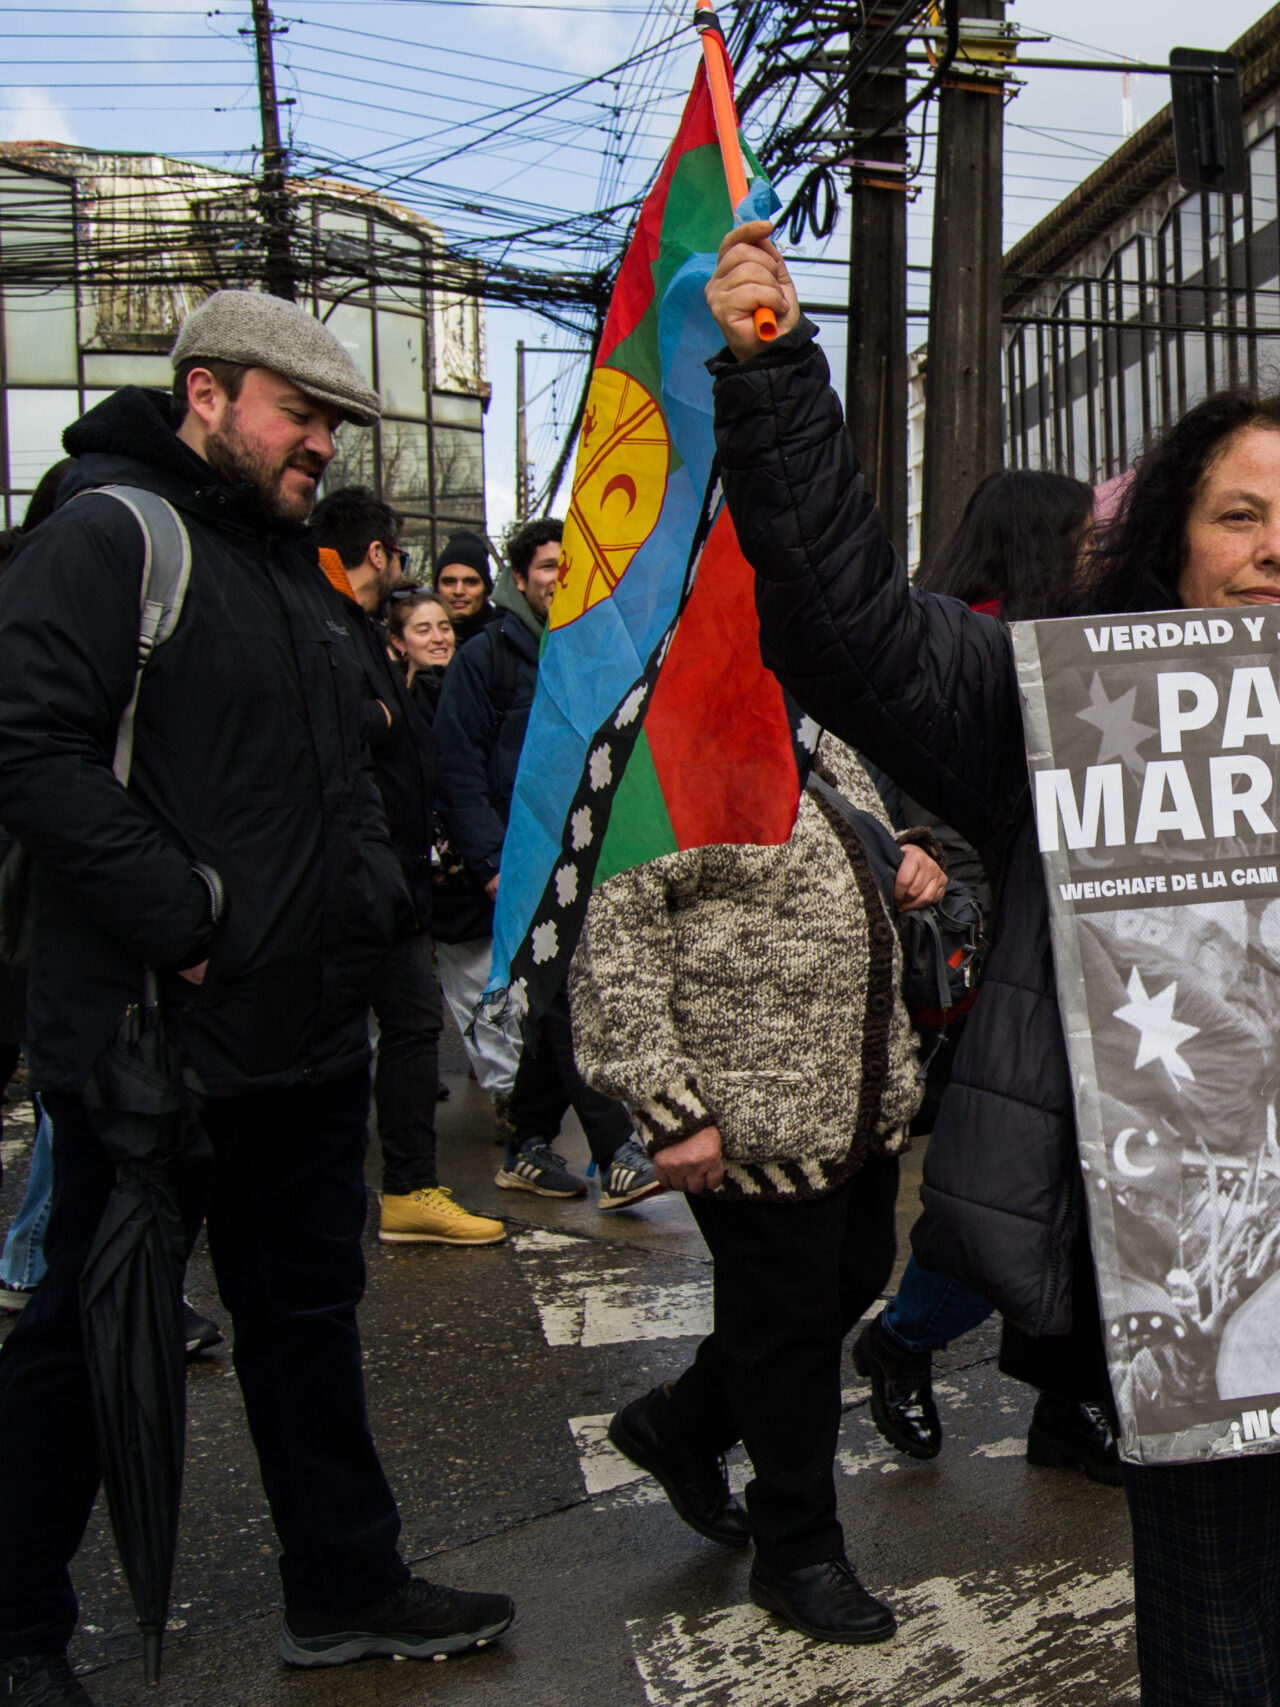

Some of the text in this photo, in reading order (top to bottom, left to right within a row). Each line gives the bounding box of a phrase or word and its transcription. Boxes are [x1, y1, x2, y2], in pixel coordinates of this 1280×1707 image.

[1084, 619, 1234, 652] VERDAD
[1241, 616, 1266, 642] Y
[1059, 876, 1167, 901] WEICHAFE
[1171, 873, 1198, 892] DE
[1202, 871, 1227, 889] LA
[1231, 866, 1278, 886] CAM
